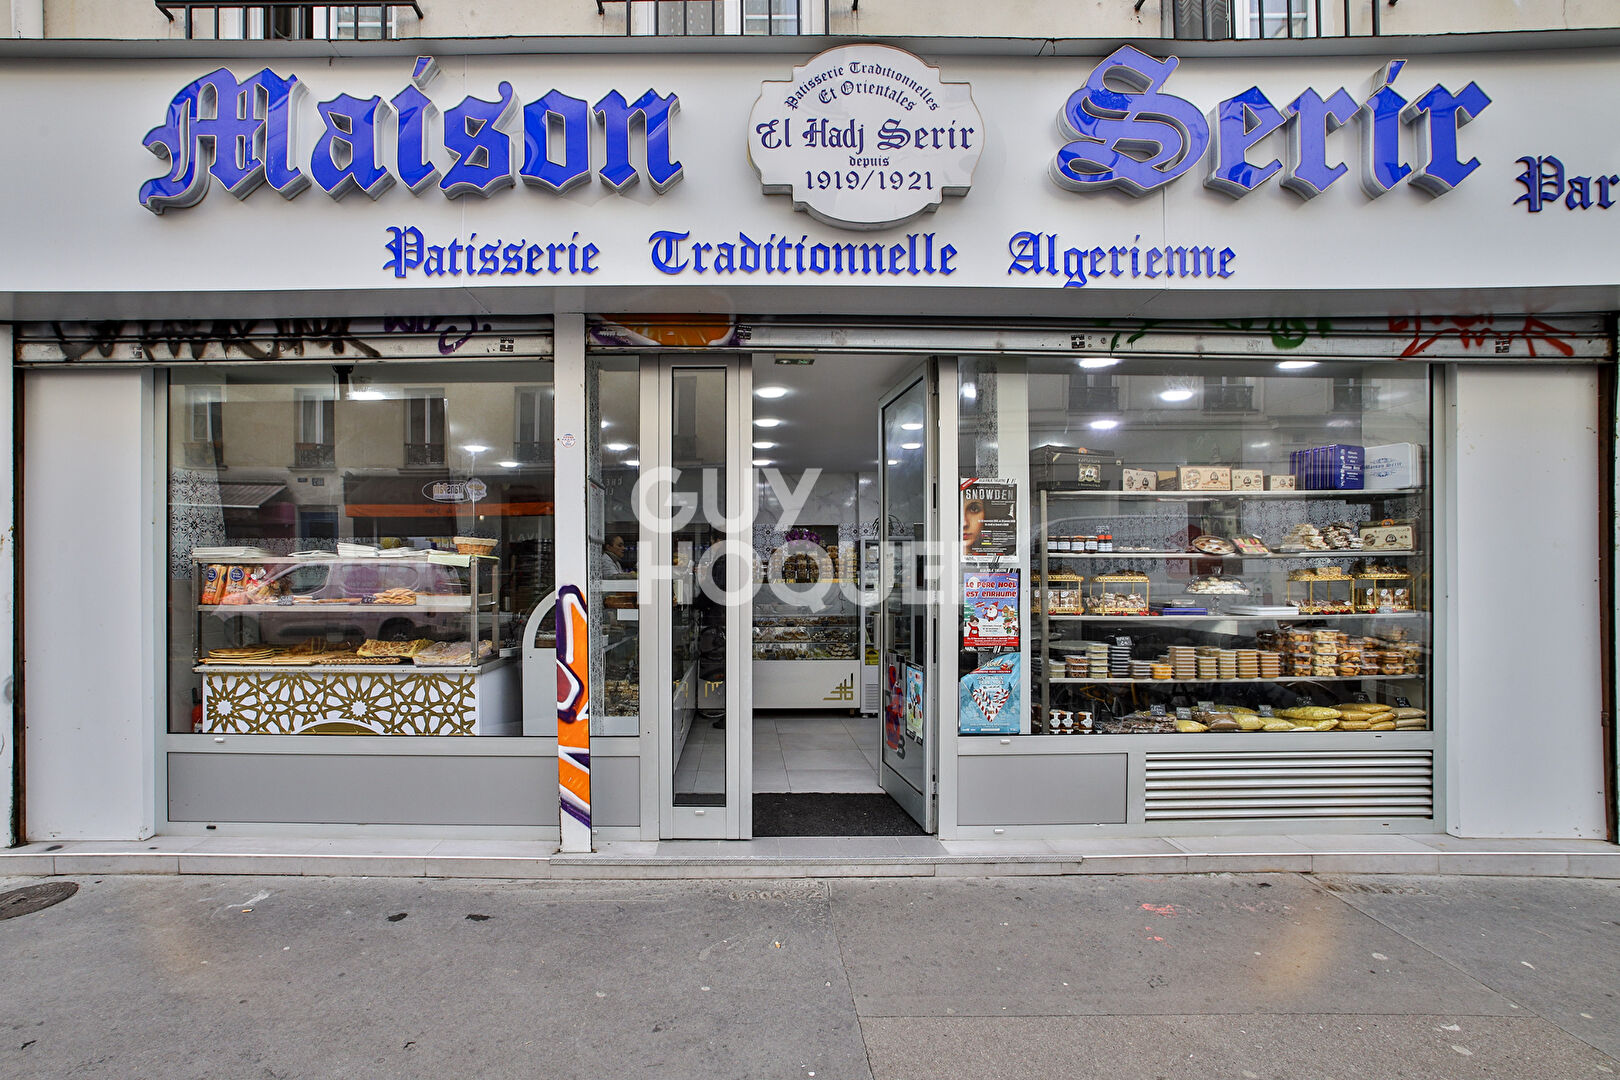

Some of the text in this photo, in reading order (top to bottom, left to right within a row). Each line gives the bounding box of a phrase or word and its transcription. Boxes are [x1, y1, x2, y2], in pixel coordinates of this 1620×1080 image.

[784, 61, 941, 112] Patisserie Traditionnelles
[818, 79, 918, 112] Et Orientales
[139, 56, 683, 213] Maison
[756, 118, 975, 155] El Hadj Serir
[1050, 44, 1493, 200] Serir
[805, 169, 934, 191] 1919/1921
[849, 156, 890, 168] depuis
[1513, 154, 1620, 213] Par
[382, 225, 1237, 288] Patisserie Traditionnelle Algerienne
[965, 488, 1014, 500] SNOWDEN
